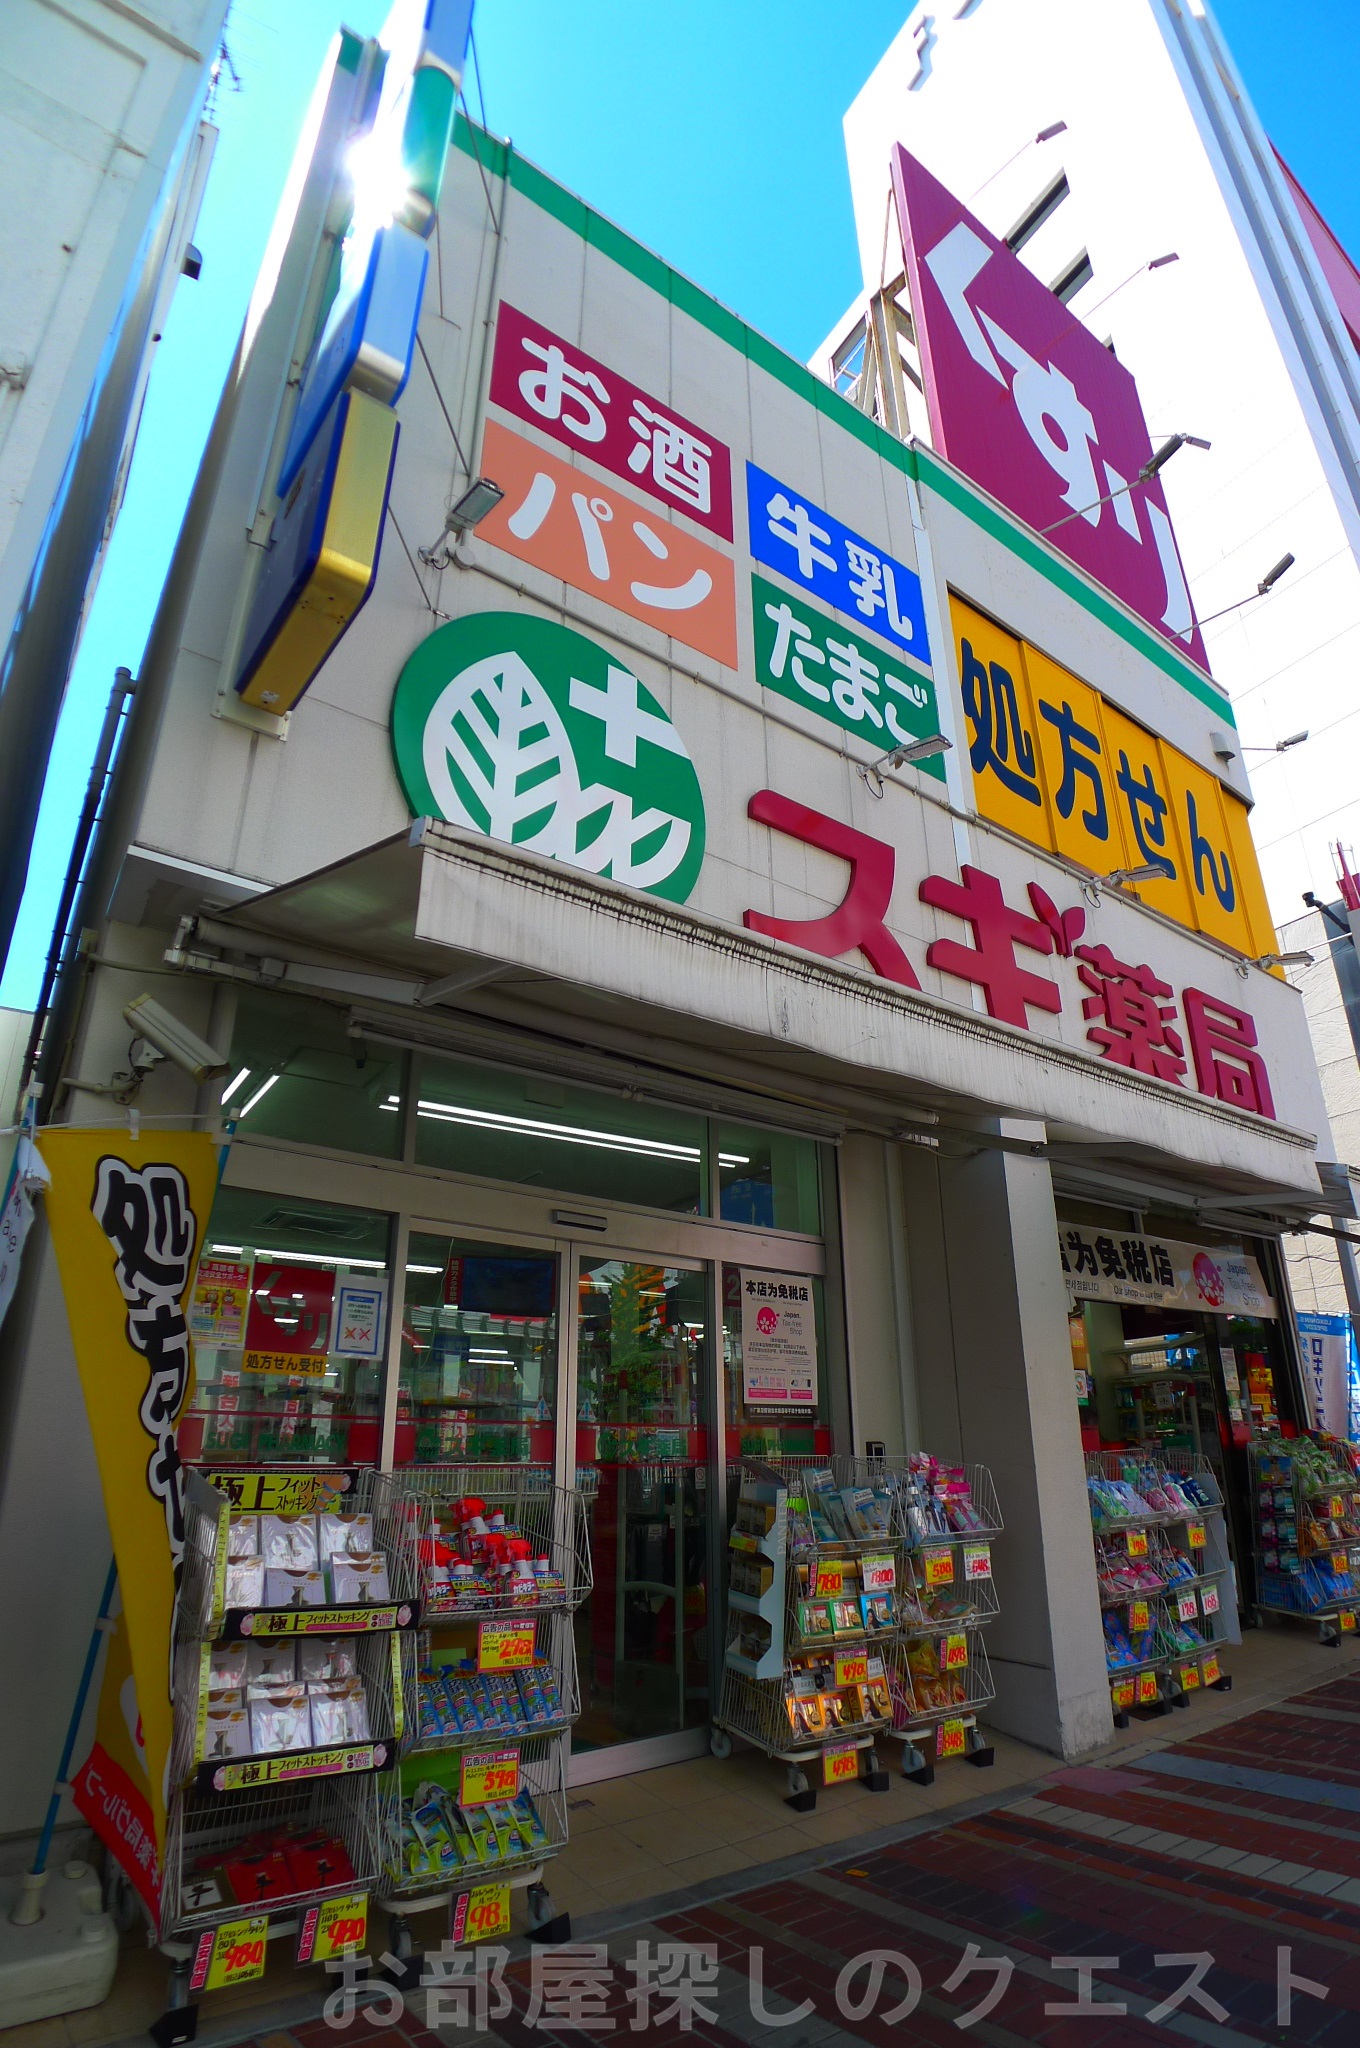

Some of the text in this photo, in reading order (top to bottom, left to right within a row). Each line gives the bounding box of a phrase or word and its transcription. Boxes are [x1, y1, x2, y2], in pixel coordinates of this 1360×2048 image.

[518, 335, 712, 514] お酒
[924, 220, 1194, 644] くすり
[508, 472, 713, 611] パン
[767, 502, 915, 642] 牛乳
[765, 602, 929, 745] たまご
[961, 636, 1236, 914] 処方せん
[743, 788, 1276, 1120] スギ薬局
[1226, 1261, 1251, 1276] Japan.
[746, 1280, 809, 1302] 本店为免税店
[1114, 1286, 1123, 1295] Our
[1124, 1287, 1138, 1298] shop
[1243, 1293, 1260, 1307] Shop
[255, 1271, 329, 1349] くすり
[784, 1311, 802, 1319] Japan.
[790, 1328, 802, 1336] Shop
[246, 1355, 325, 1372] 処方せん受付
[92, 1155, 196, 1670] 処方せ
[213, 1476, 275, 1511] 極上
[279, 1477, 320, 1493] フィット
[275, 1494, 318, 1511] ストッキング
[818, 1573, 842, 1592] 780
[469, 1902, 501, 1931] 98
[328, 1917, 365, 1949] 980
[224, 1940, 264, 1973] 980
